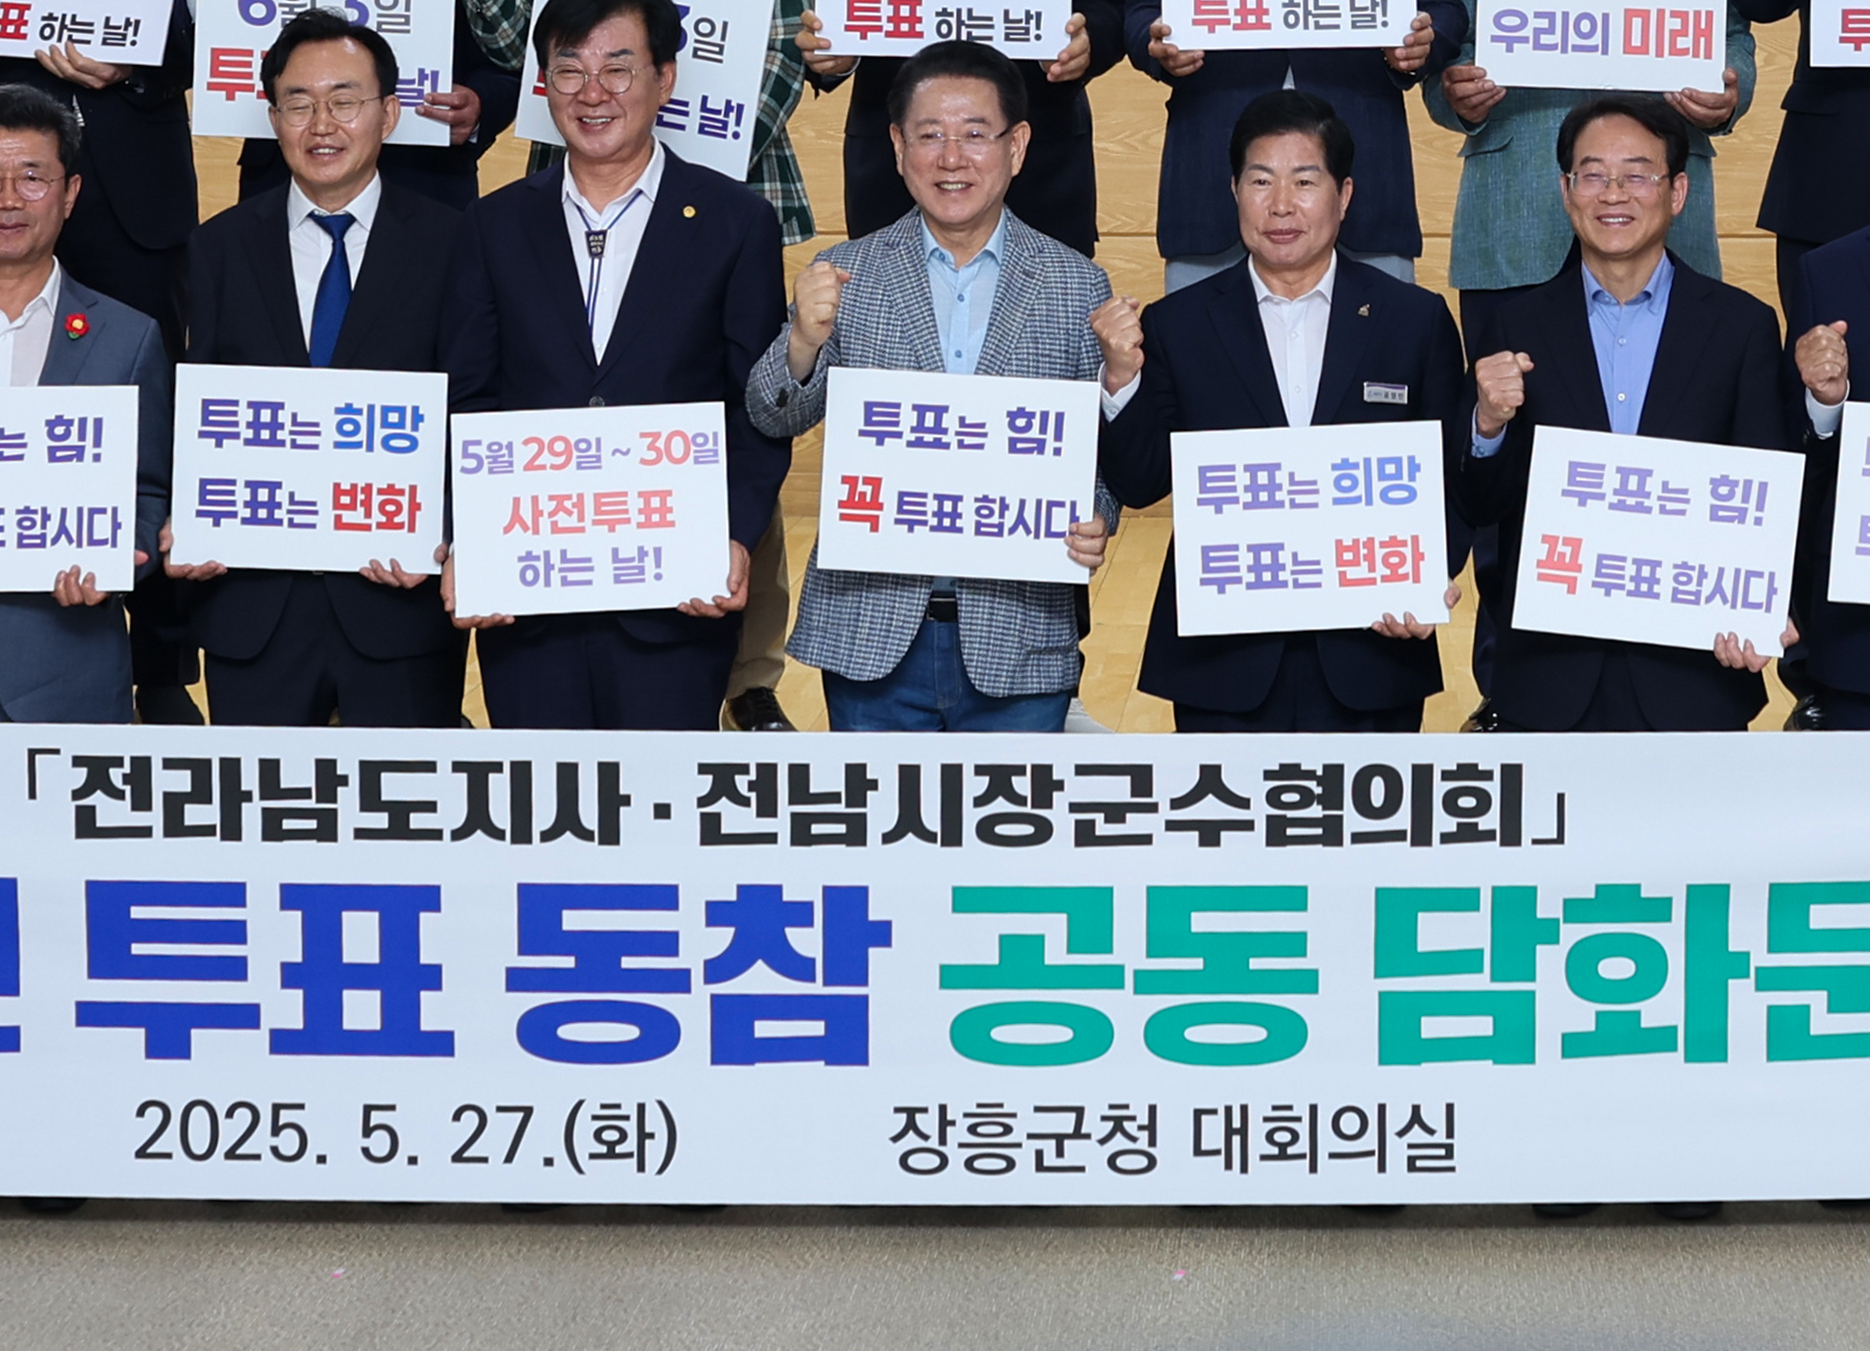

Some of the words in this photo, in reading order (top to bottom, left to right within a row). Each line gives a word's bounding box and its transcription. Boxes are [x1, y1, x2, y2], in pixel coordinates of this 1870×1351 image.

[39, 12, 95, 43] 하는
[101, 16, 141, 47] 날!
[935, 7, 993, 39] 하는
[1003, 9, 1042, 42] 날!
[1491, 9, 1609, 55] 우리의
[1623, 8, 1713, 59] 미래
[698, 95, 745, 140] 날!
[45, 415, 103, 463] 힘!
[198, 399, 321, 450] 투표는
[333, 403, 424, 454] 희망
[460, 440, 513, 474] 5월
[522, 436, 601, 471] 29일
[640, 430, 719, 466] 30일
[858, 401, 988, 450] 투표는
[1006, 407, 1065, 456] 힘!
[195, 478, 319, 529] 투표는
[332, 482, 421, 533] 변화
[503, 490, 675, 535] 사전투표
[838, 475, 884, 533] 꼭
[894, 491, 963, 534] 투표
[973, 494, 1079, 540] 합시다
[1197, 463, 1319, 514] 투표는
[1331, 456, 1420, 506] 희망
[1562, 461, 1690, 515] 투표는
[1710, 475, 1768, 526] 힘!
[15, 506, 122, 549] 합시다
[518, 549, 594, 587] 하는
[612, 546, 662, 584] 날!
[1200, 543, 1322, 594] 투표는
[1335, 535, 1424, 587] 변화
[1536, 535, 1582, 594] 꼭
[1592, 554, 1662, 599] 투표
[1671, 562, 1777, 613] 합시다
[75, 880, 455, 1060] 투표
[505, 883, 892, 1066] 동참
[939, 885, 1319, 1067] 공동
[135, 1099, 327, 1164] 2025.
[361, 1104, 418, 1165] 5.
[889, 1103, 1157, 1175] 장흥군청
[1193, 1103, 1456, 1174] 대회의실
